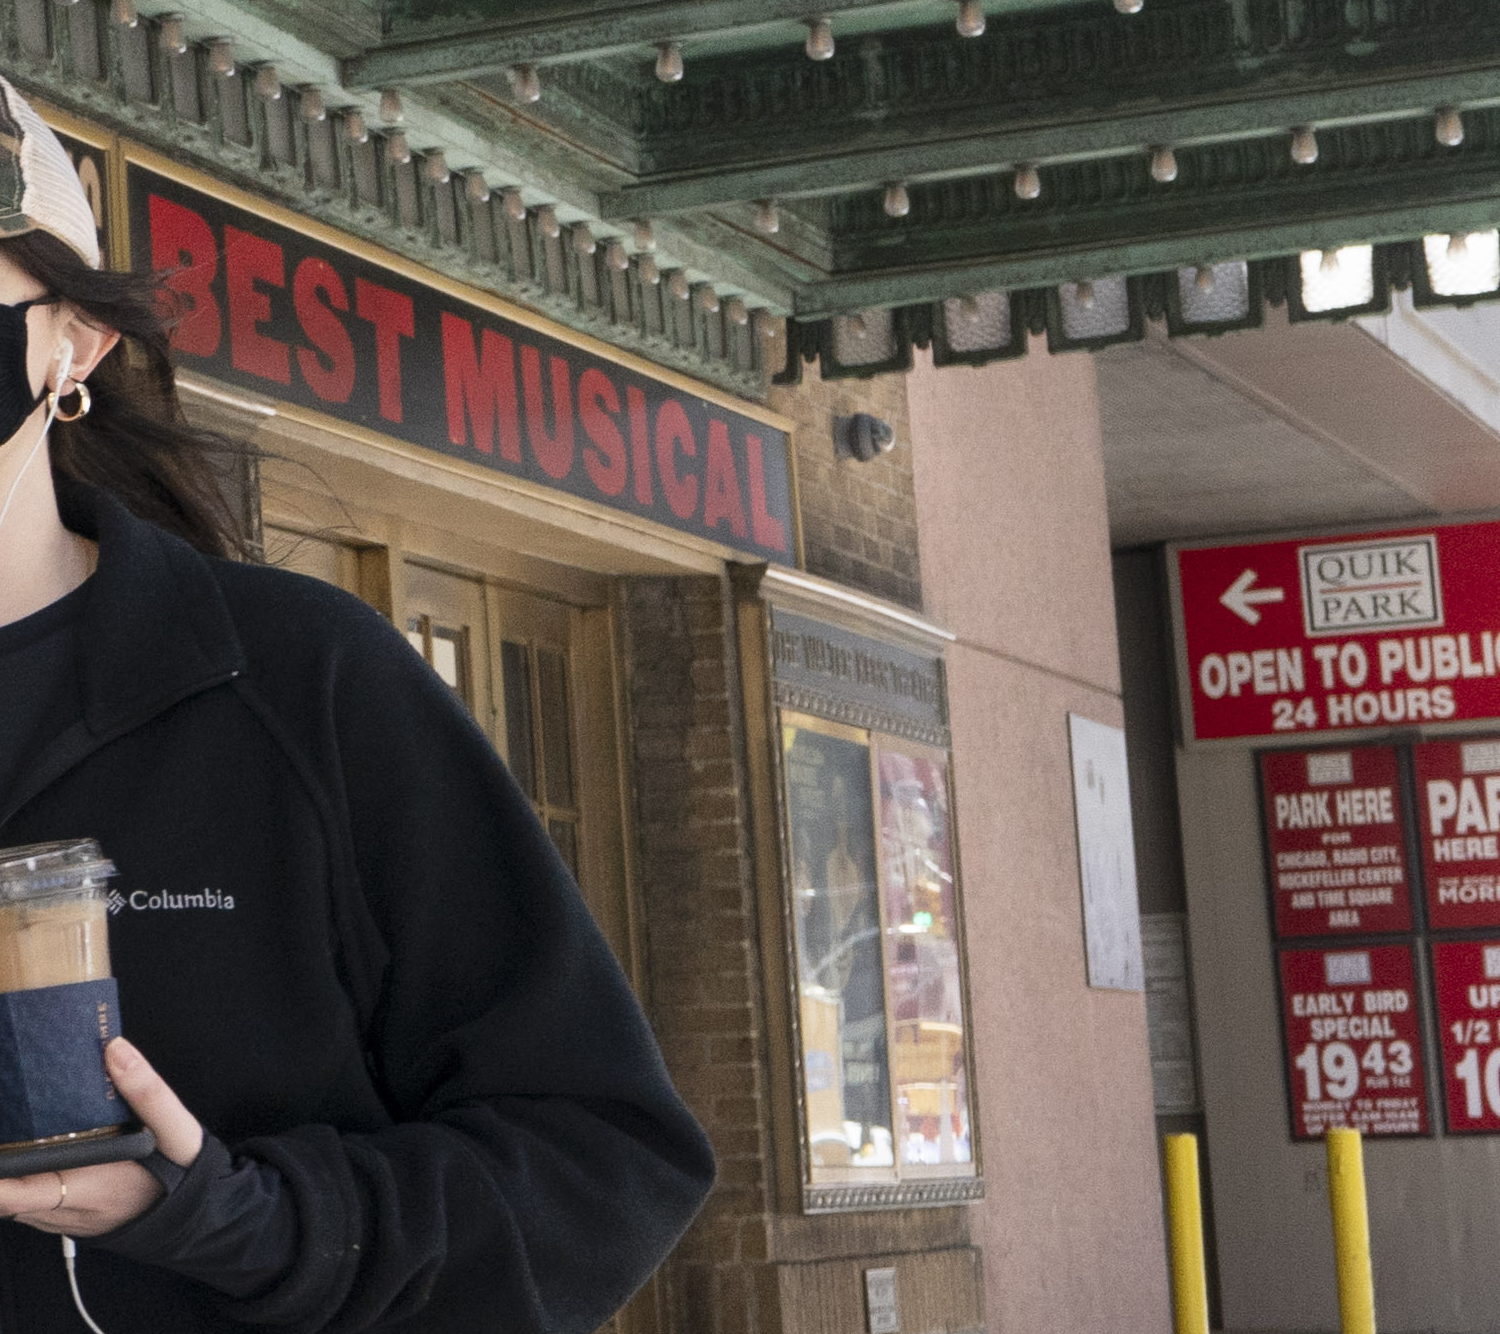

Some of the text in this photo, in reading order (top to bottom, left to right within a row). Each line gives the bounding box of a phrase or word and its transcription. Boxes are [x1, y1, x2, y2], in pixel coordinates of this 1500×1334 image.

[149, 192, 416, 423] BEST
[440, 311, 787, 552] MUSICAL
[1316, 548, 1423, 587] QUIK
[1321, 589, 1424, 623] PARK
[1199, 646, 1306, 700] OPEN
[1313, 641, 1368, 689] TO
[1272, 686, 1457, 731] 24 HOURS
[1274, 786, 1396, 830] PARK HERE
[1433, 835, 1499, 863] HERE
[1278, 866, 1404, 890] ROCKEFELLER CENTER
[129, 887, 235, 910] Columbia
[1438, 884, 1500, 905] MOR
[1291, 989, 1410, 1017] EARLY BIRD
[1310, 1016, 1396, 1041] SPECIAL
[1451, 1019, 1491, 1046] 1/2
